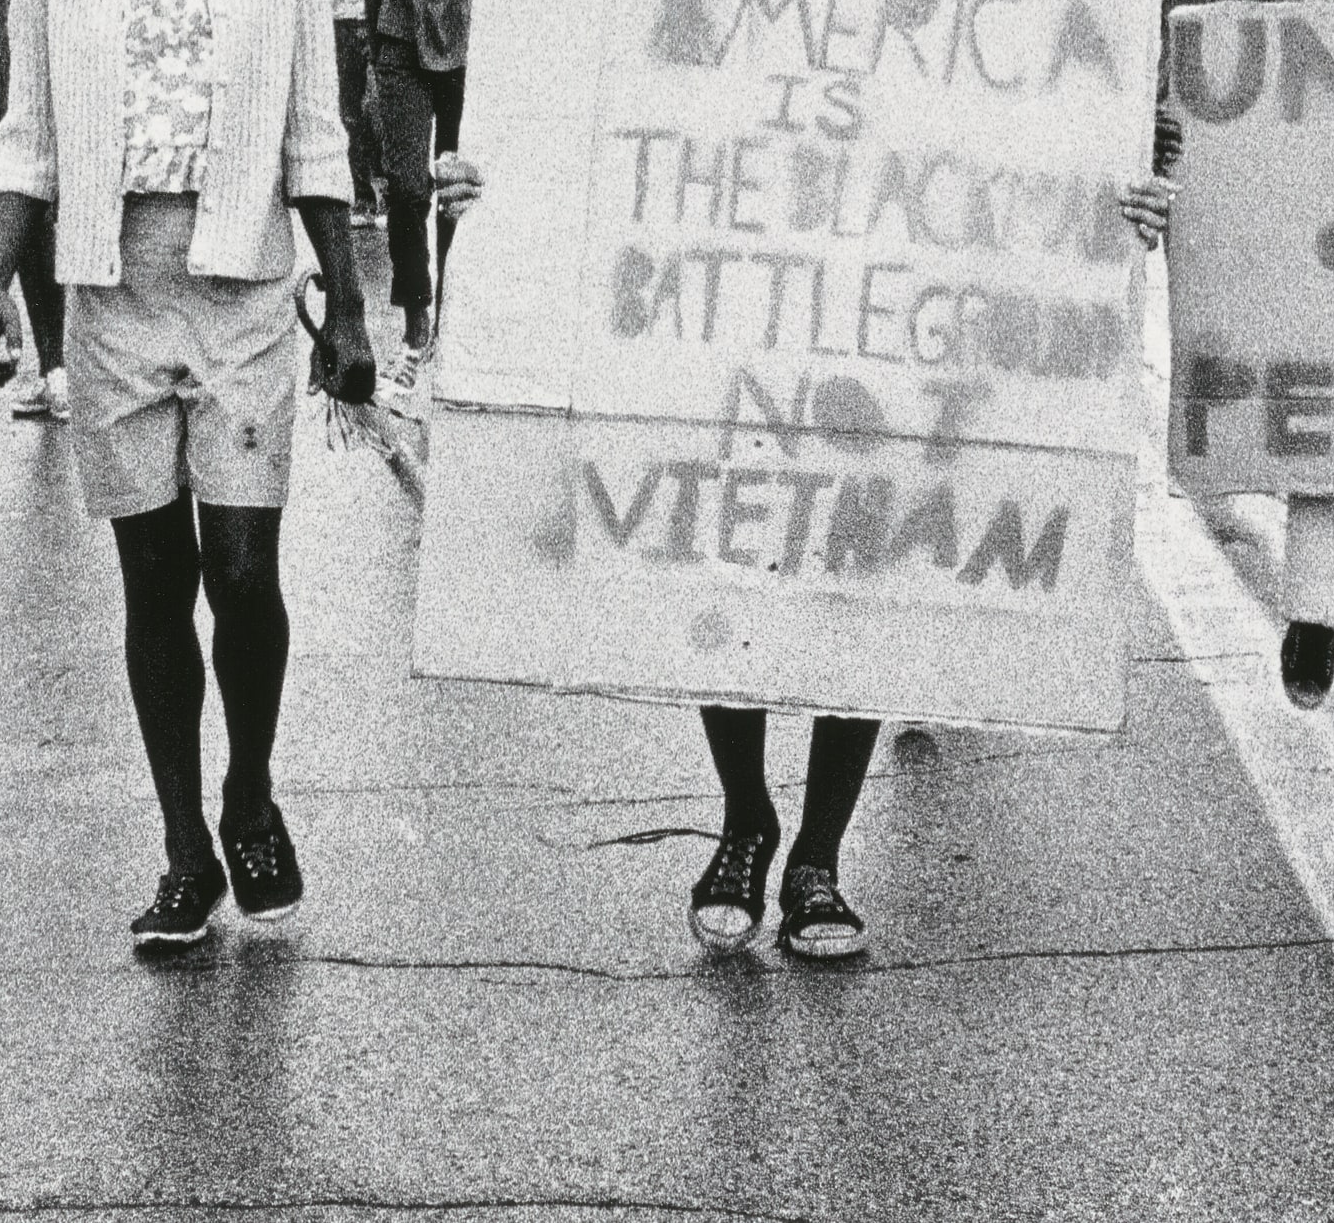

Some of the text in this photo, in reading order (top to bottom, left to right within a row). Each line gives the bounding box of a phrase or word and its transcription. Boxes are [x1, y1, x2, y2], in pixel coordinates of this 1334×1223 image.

[758, 74, 862, 138] IS
[612, 127, 768, 234] THE
[720, 365, 995, 466] NOT
[581, 458, 1071, 595] VIETNAM
